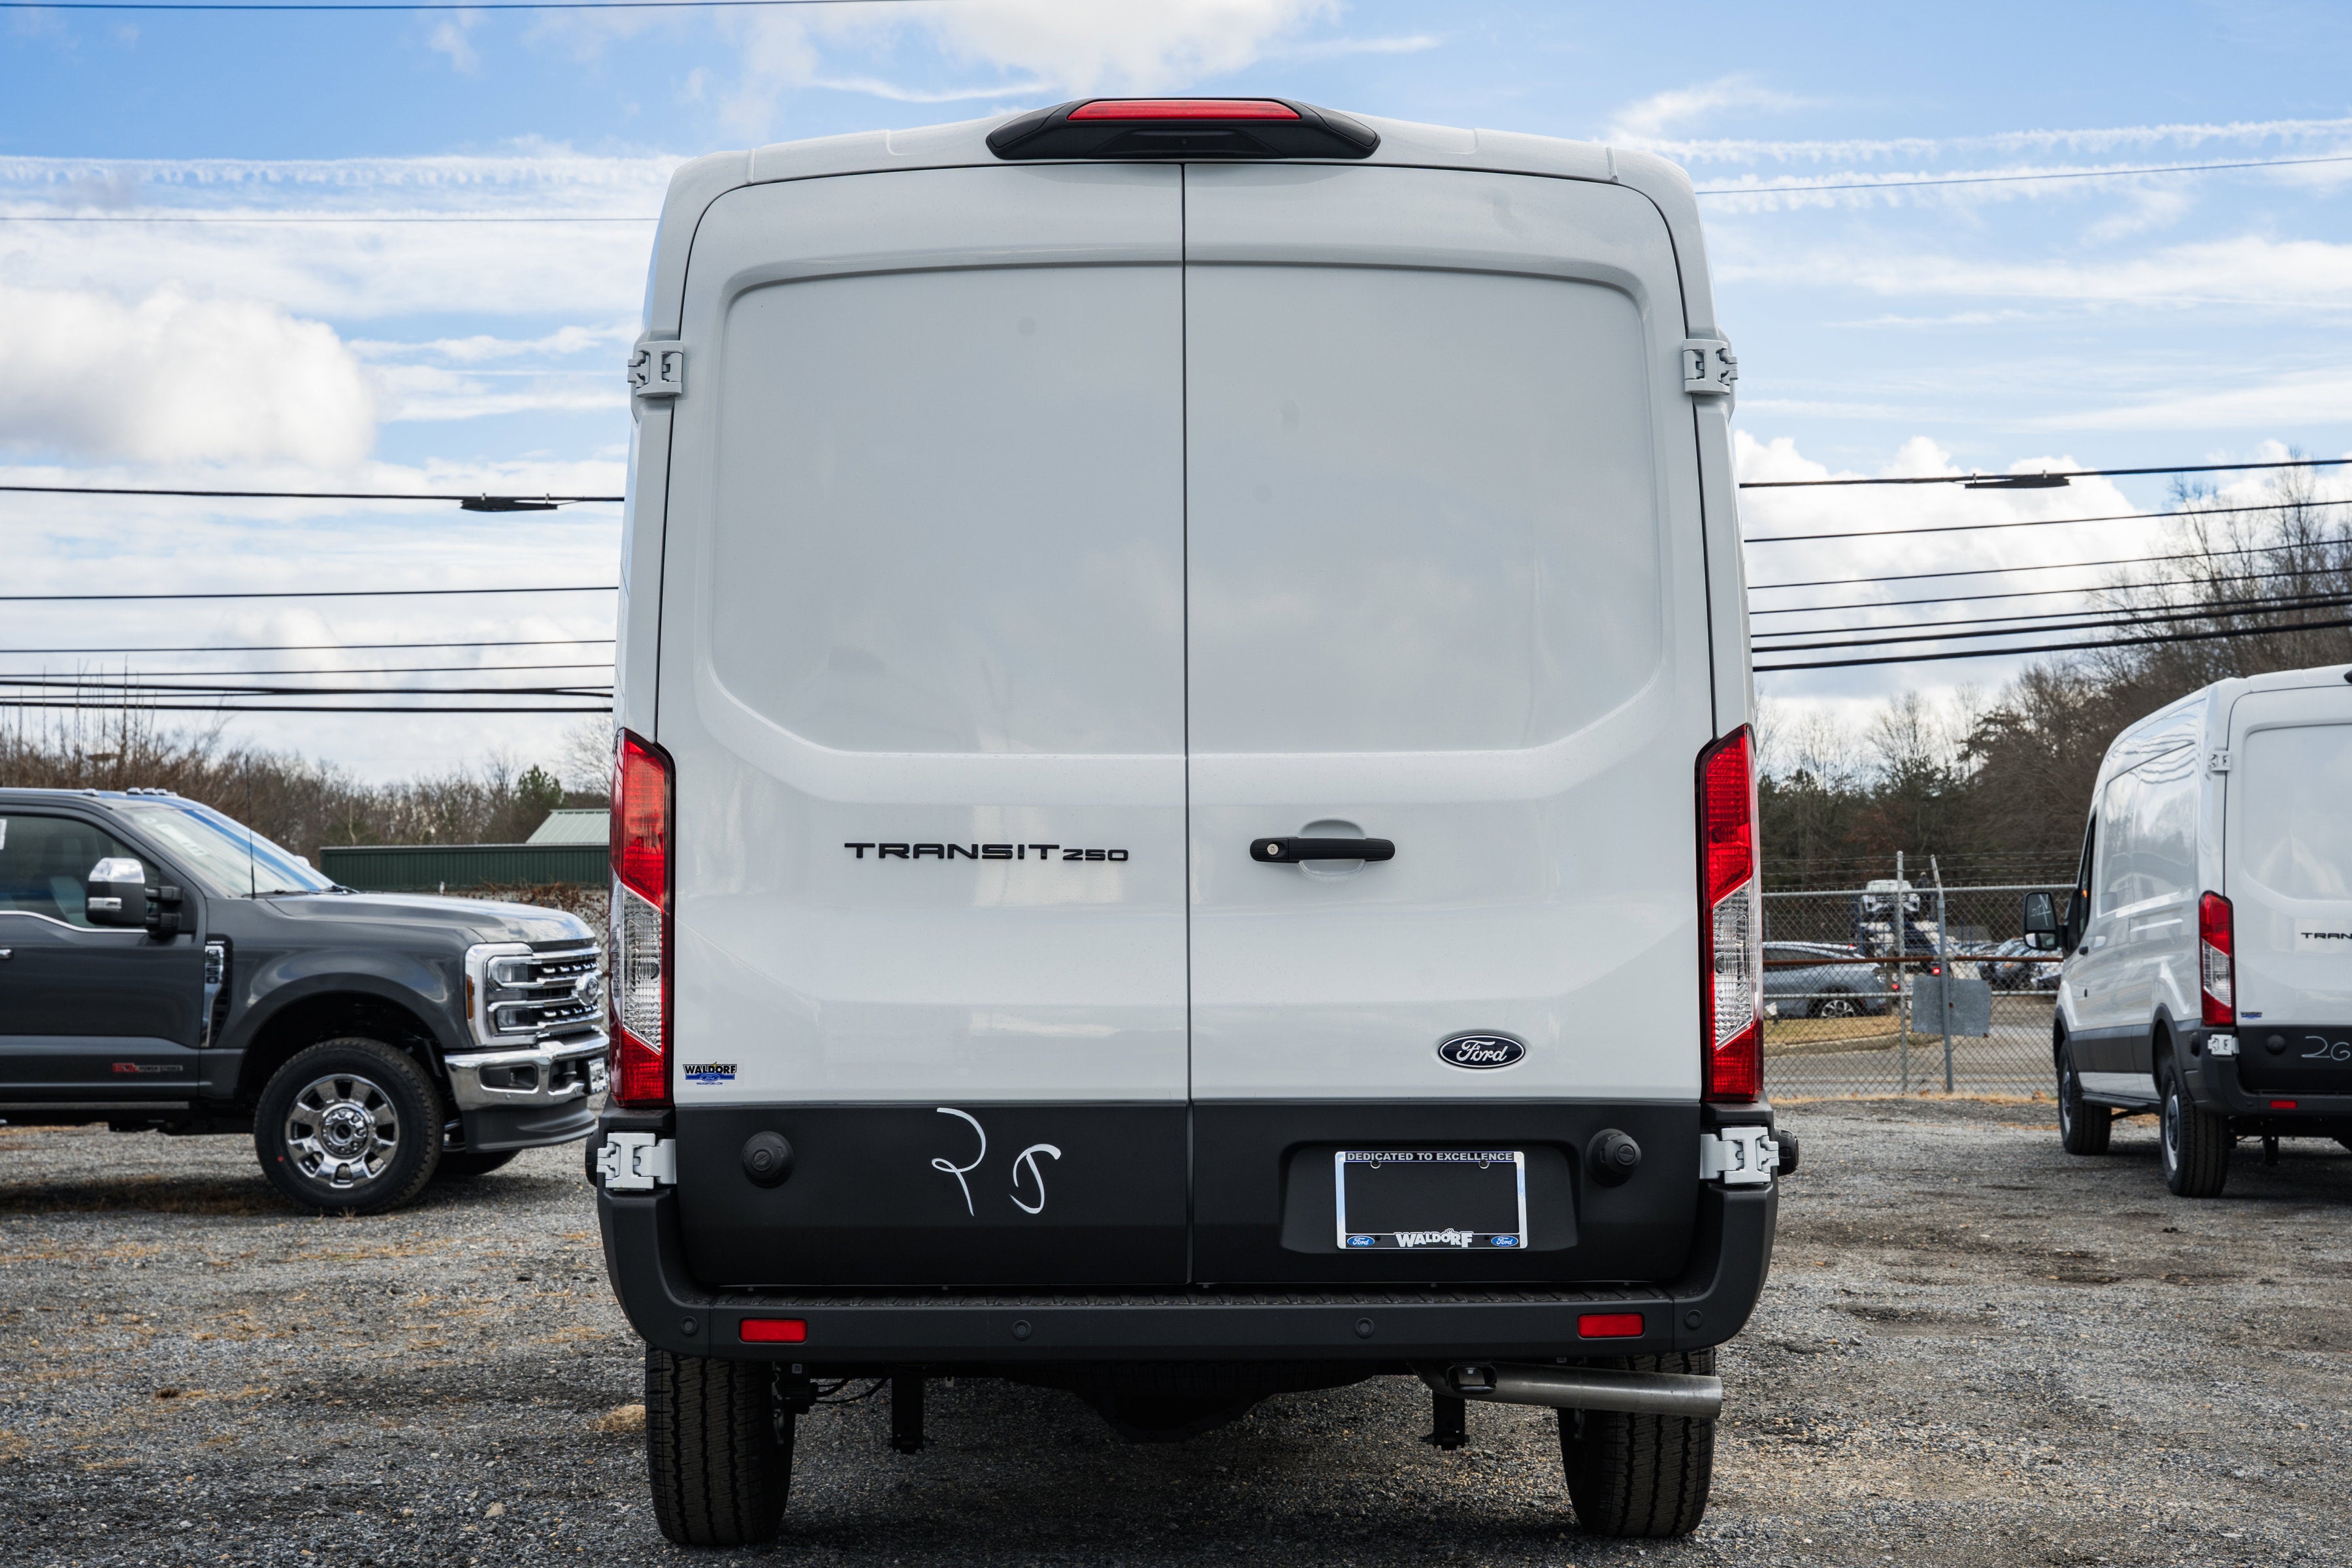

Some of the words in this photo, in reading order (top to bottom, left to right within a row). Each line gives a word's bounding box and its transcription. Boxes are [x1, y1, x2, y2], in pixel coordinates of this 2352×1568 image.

[844, 842, 1060, 860] TRANSIT
[1063, 848, 1128, 861] 250
[1456, 1039, 1509, 1062] Ford
[684, 1065, 736, 1074] WALDORF
[1347, 1152, 1414, 1161] DEDICATED
[1416, 1152, 1433, 1161] TO
[1437, 1152, 1513, 1161] EXCELLENCE
[1352, 1237, 1369, 1245] Ford
[1395, 1232, 1473, 1248] WALDORF
[1496, 1237, 1513, 1245] Ford
